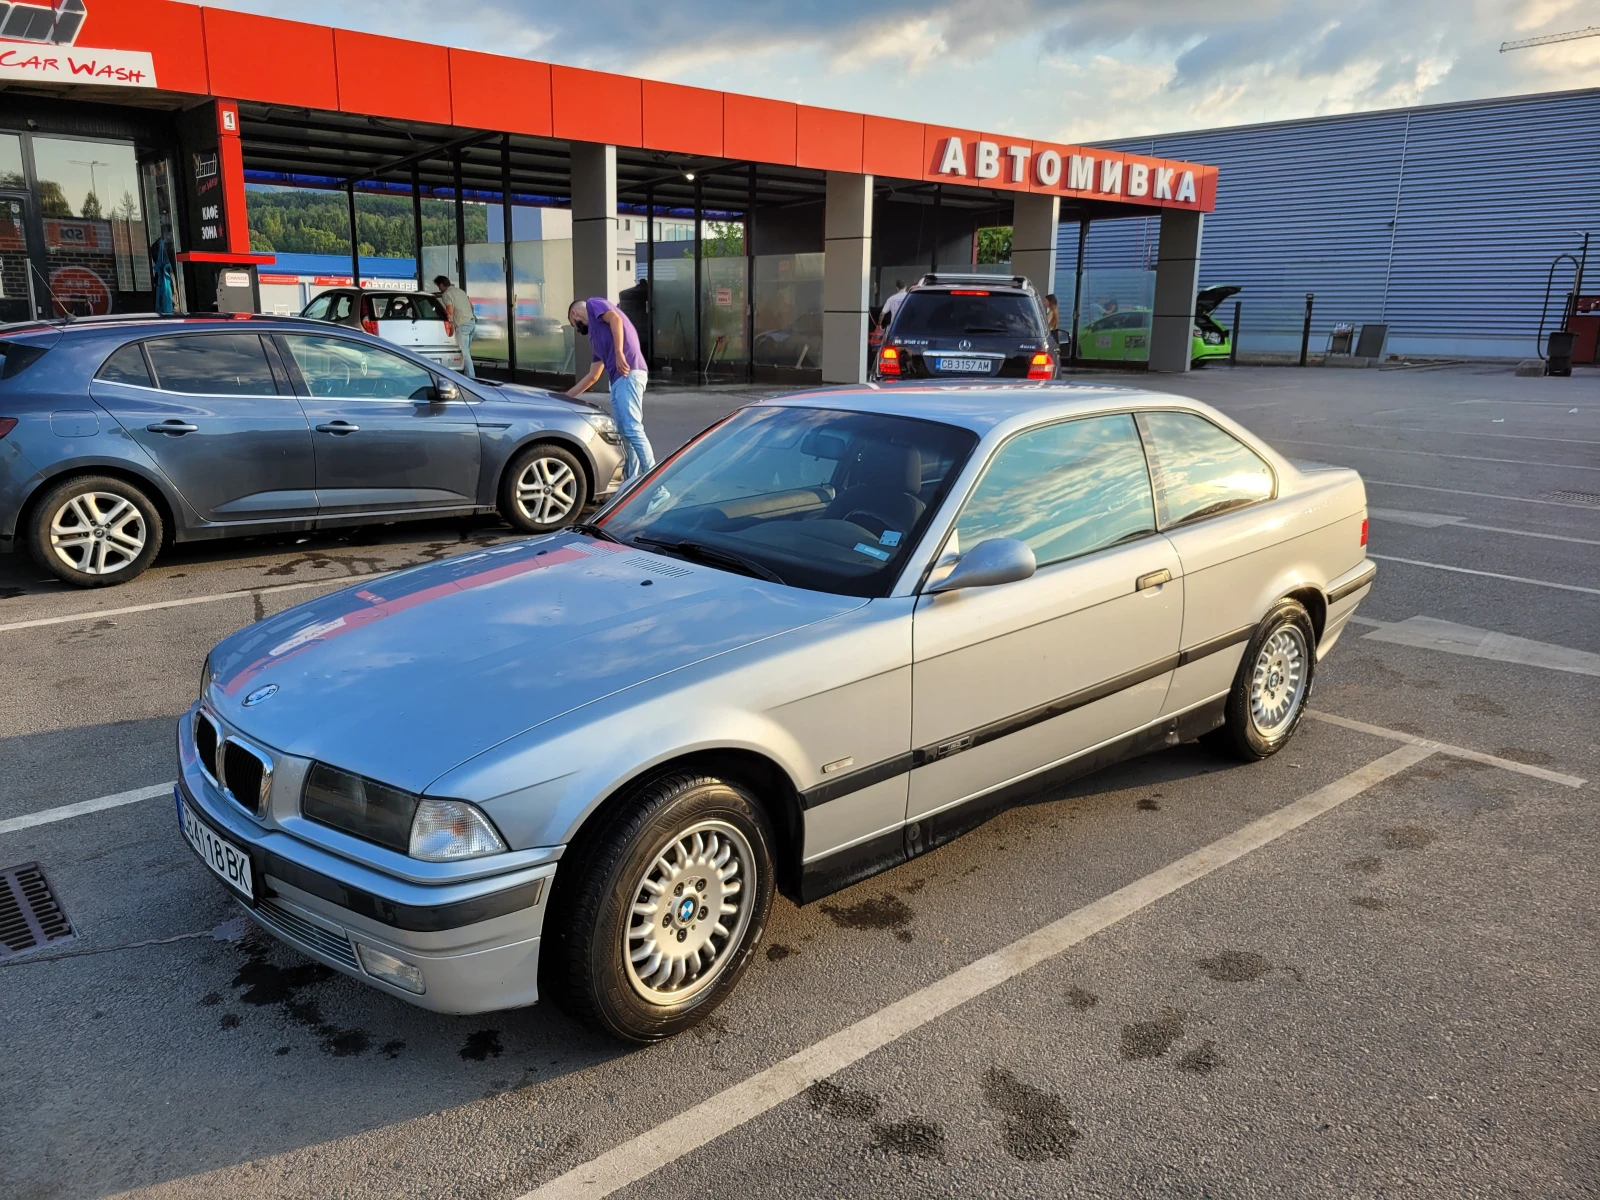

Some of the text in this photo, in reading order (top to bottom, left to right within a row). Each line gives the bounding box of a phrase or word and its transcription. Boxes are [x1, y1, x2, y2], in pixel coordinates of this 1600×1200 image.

[0, 50, 146, 83] CAR WASH
[225, 113, 233, 124] 1
[938, 136, 1197, 203] АВТОМИВКА
[201, 205, 219, 221] КАФЕ
[201, 225, 218, 240] ЗОНА
[941, 359, 990, 371] CB 3157 AM
[194, 820, 225, 872] 4118
[225, 845, 250, 892] BK
